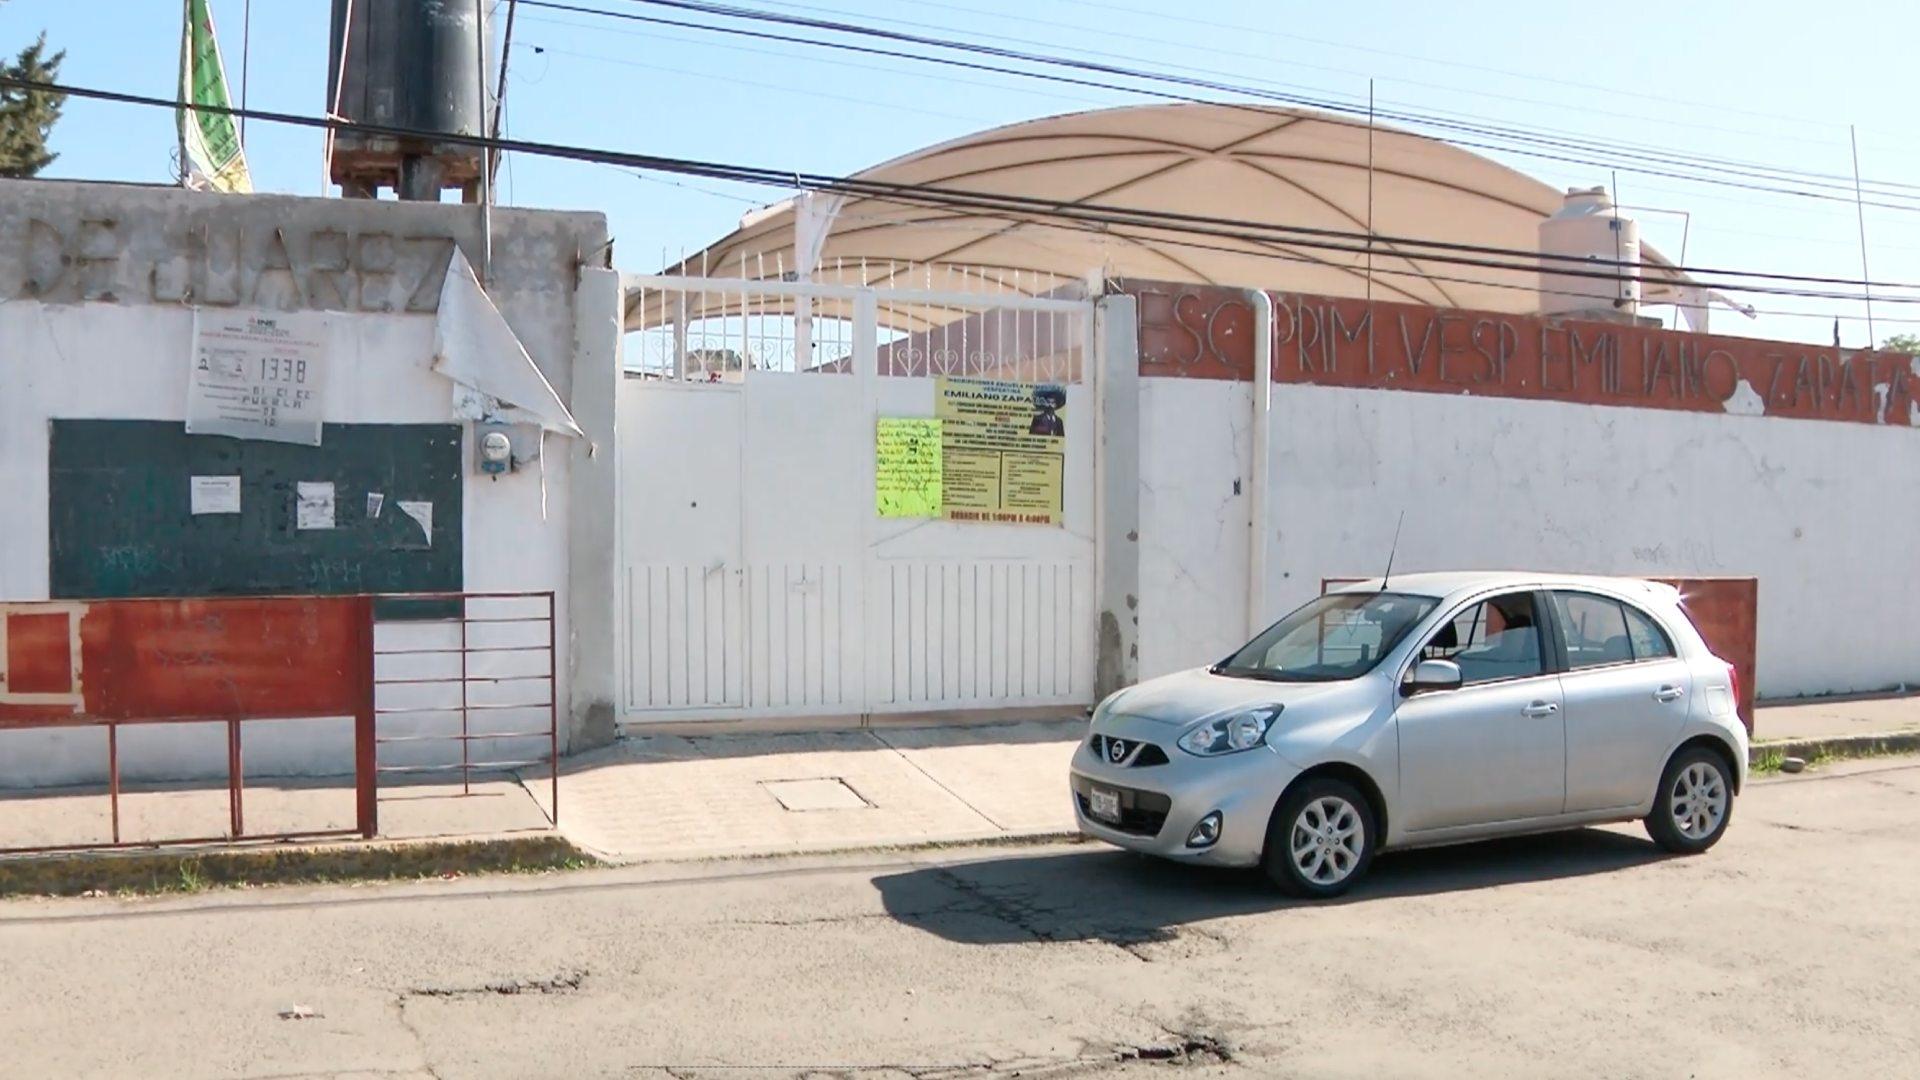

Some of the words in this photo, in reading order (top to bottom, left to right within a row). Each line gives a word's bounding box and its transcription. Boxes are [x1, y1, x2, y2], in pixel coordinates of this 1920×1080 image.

[261, 357, 306, 384] 1338
[1540, 322, 1739, 403] EMILIANO
[1764, 351, 1912, 419] ZAPATA
[943, 389, 999, 401] EMILIANO
